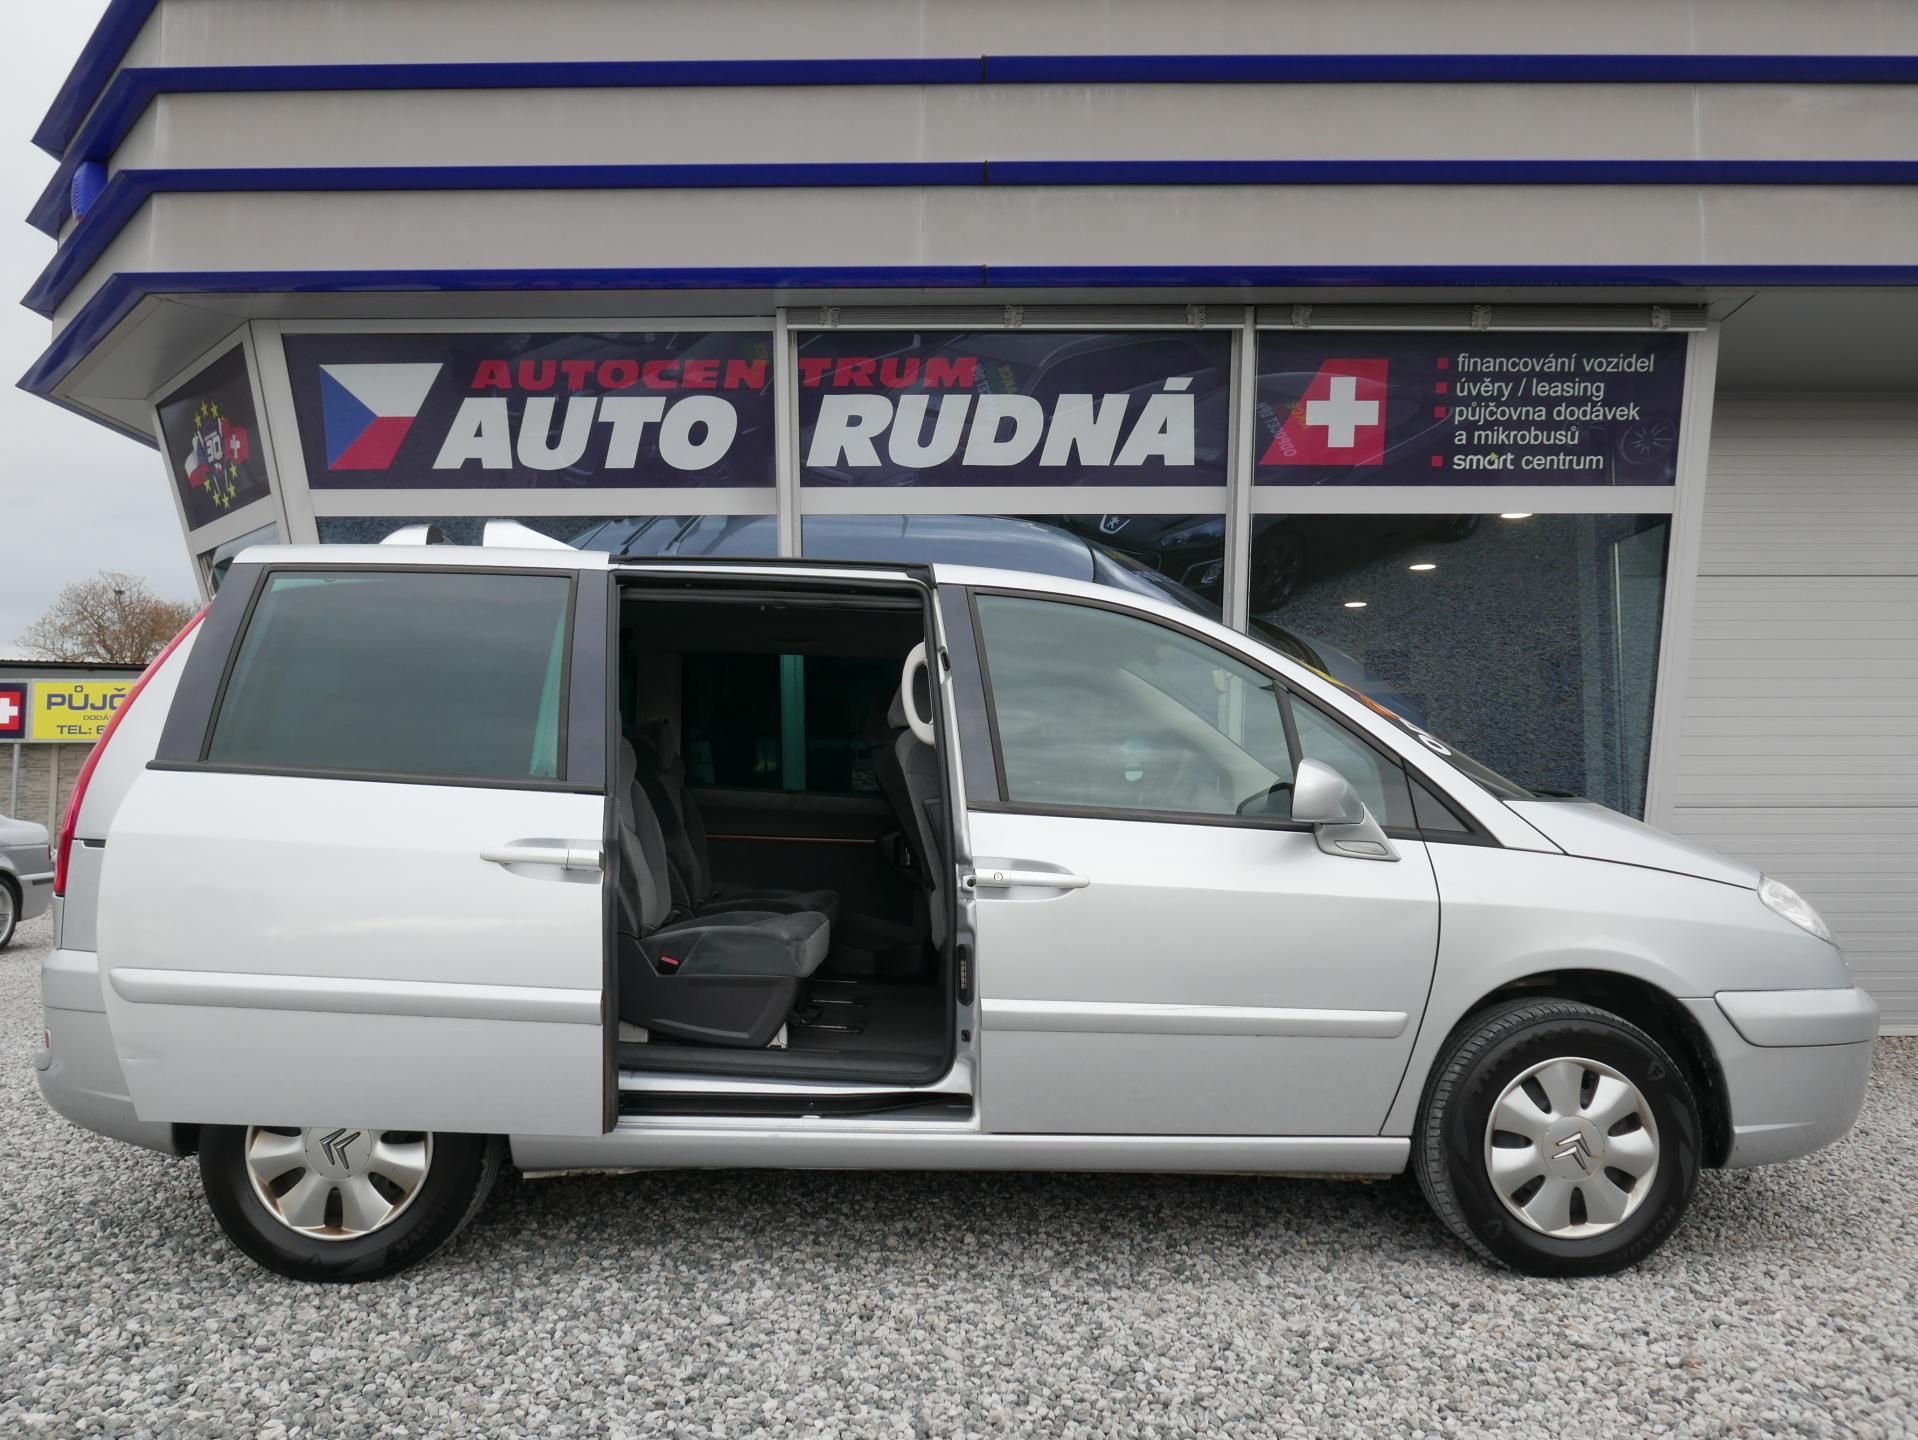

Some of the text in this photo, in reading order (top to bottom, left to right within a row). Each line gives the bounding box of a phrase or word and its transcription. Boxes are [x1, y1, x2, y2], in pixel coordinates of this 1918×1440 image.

[1456, 353, 1655, 373] financování vozidel
[1456, 378, 1605, 401] úvěry / leasing
[432, 377, 1195, 471] AUTO RUDNÁ
[1453, 401, 1641, 425] půjčovna dodávek
[1453, 425, 1580, 445] a mikrobusů
[206, 434, 223, 464] 30
[1452, 452, 1604, 470] smart centrum
[46, 685, 127, 711] PŮJČ
[56, 725, 92, 735] TEL:
